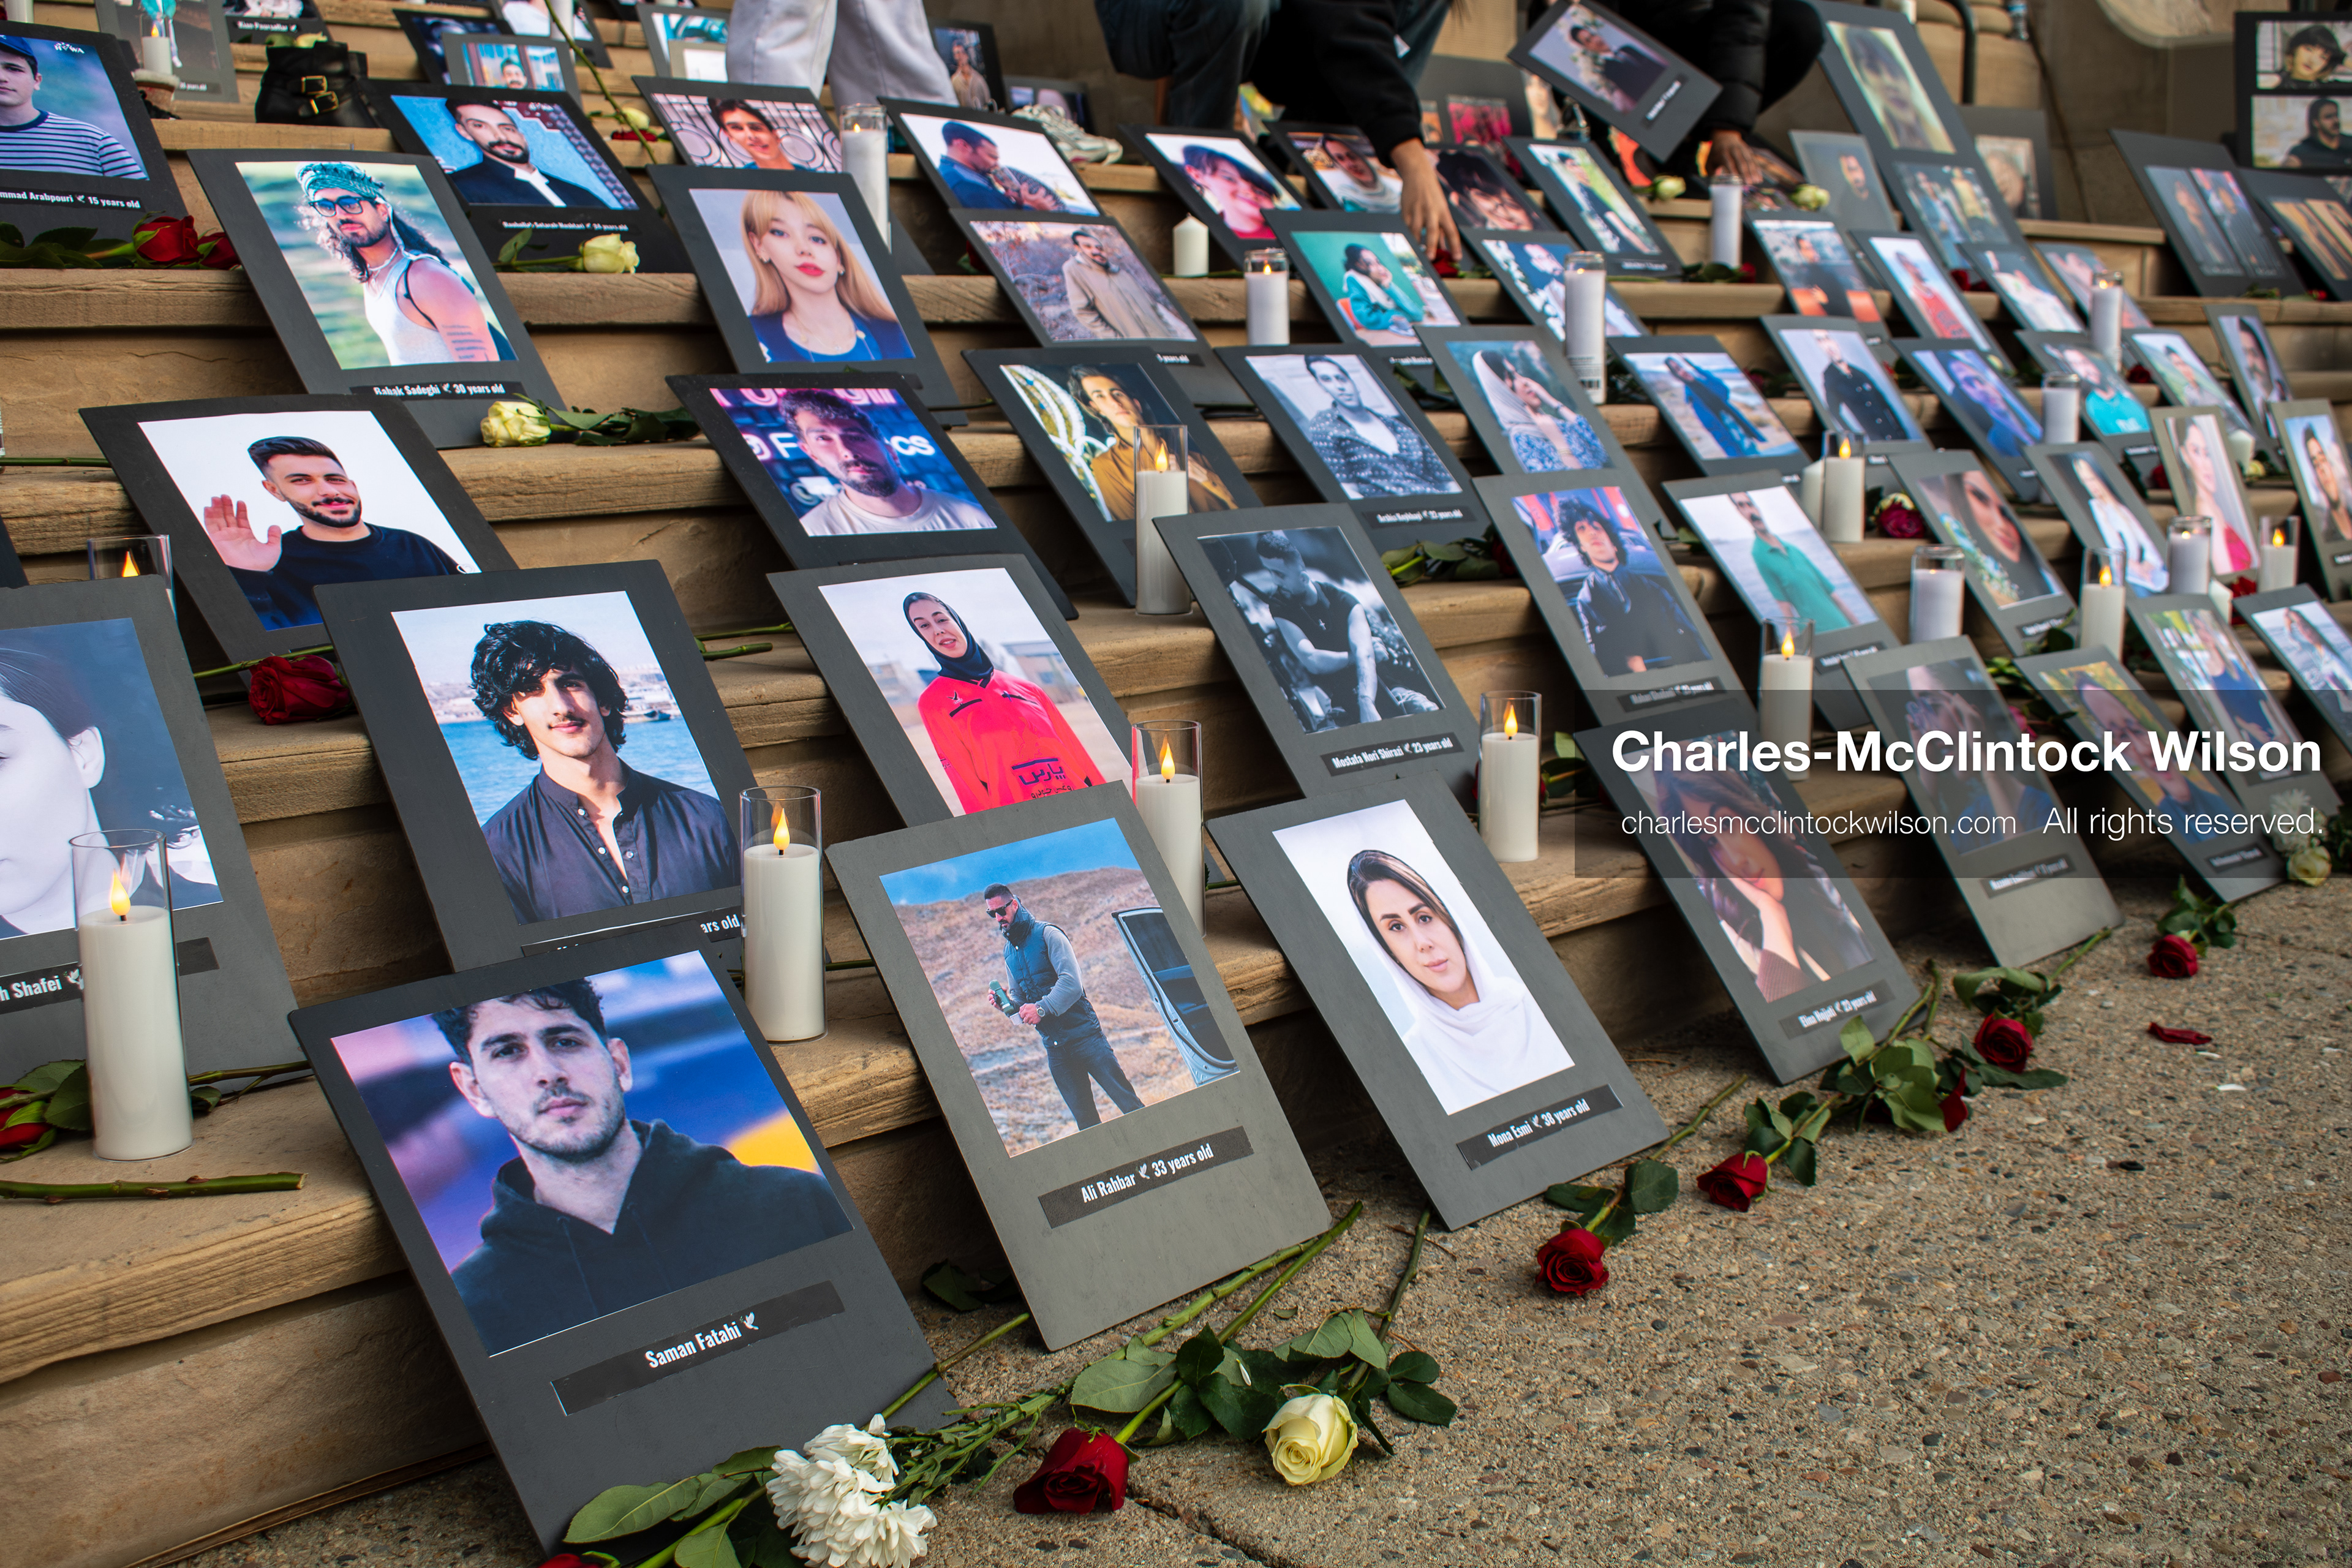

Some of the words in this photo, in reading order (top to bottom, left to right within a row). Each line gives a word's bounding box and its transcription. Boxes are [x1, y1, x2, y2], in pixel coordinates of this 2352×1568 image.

[29, 192, 74, 203] Arabpouri
[88, 196, 99, 205] 15
[100, 198, 125, 207] years
[126, 200, 141, 209] old
[404, 385, 441, 397] Sadeghi
[453, 383, 467, 394] 30
[467, 385, 490, 396] years
[491, 383, 505, 394] old
[1437, 511, 1454, 521] years
[1452, 509, 1463, 518] old
[1690, 684, 1706, 696] years
[1703, 680, 1714, 691] old
[1332, 756, 1364, 769] Mostafa
[1361, 750, 1380, 762] Nori
[1377, 745, 1404, 760] Shirazi
[1411, 742, 1424, 753] 23
[1422, 741, 1442, 753] years
[1439, 737, 1453, 748] old
[721, 914, 741, 929] old
[12, 975, 62, 998] Shafei
[1850, 996, 1868, 1011] years
[1864, 990, 1877, 1003] old
[1487, 1130, 1514, 1148] Mona
[1509, 1120, 1534, 1139] Esmi
[1540, 1111, 1556, 1126] 38
[1553, 1106, 1577, 1125] years
[1575, 1098, 1591, 1114] old
[1081, 1183, 1098, 1203] Ali
[1096, 1173, 1136, 1197] Rahbar
[1152, 1159, 1167, 1177] 33
[1167, 1152, 1197, 1174] years
[1196, 1143, 1214, 1161] old
[645, 1340, 697, 1368] Saman
[695, 1321, 742, 1351] Fatahi
